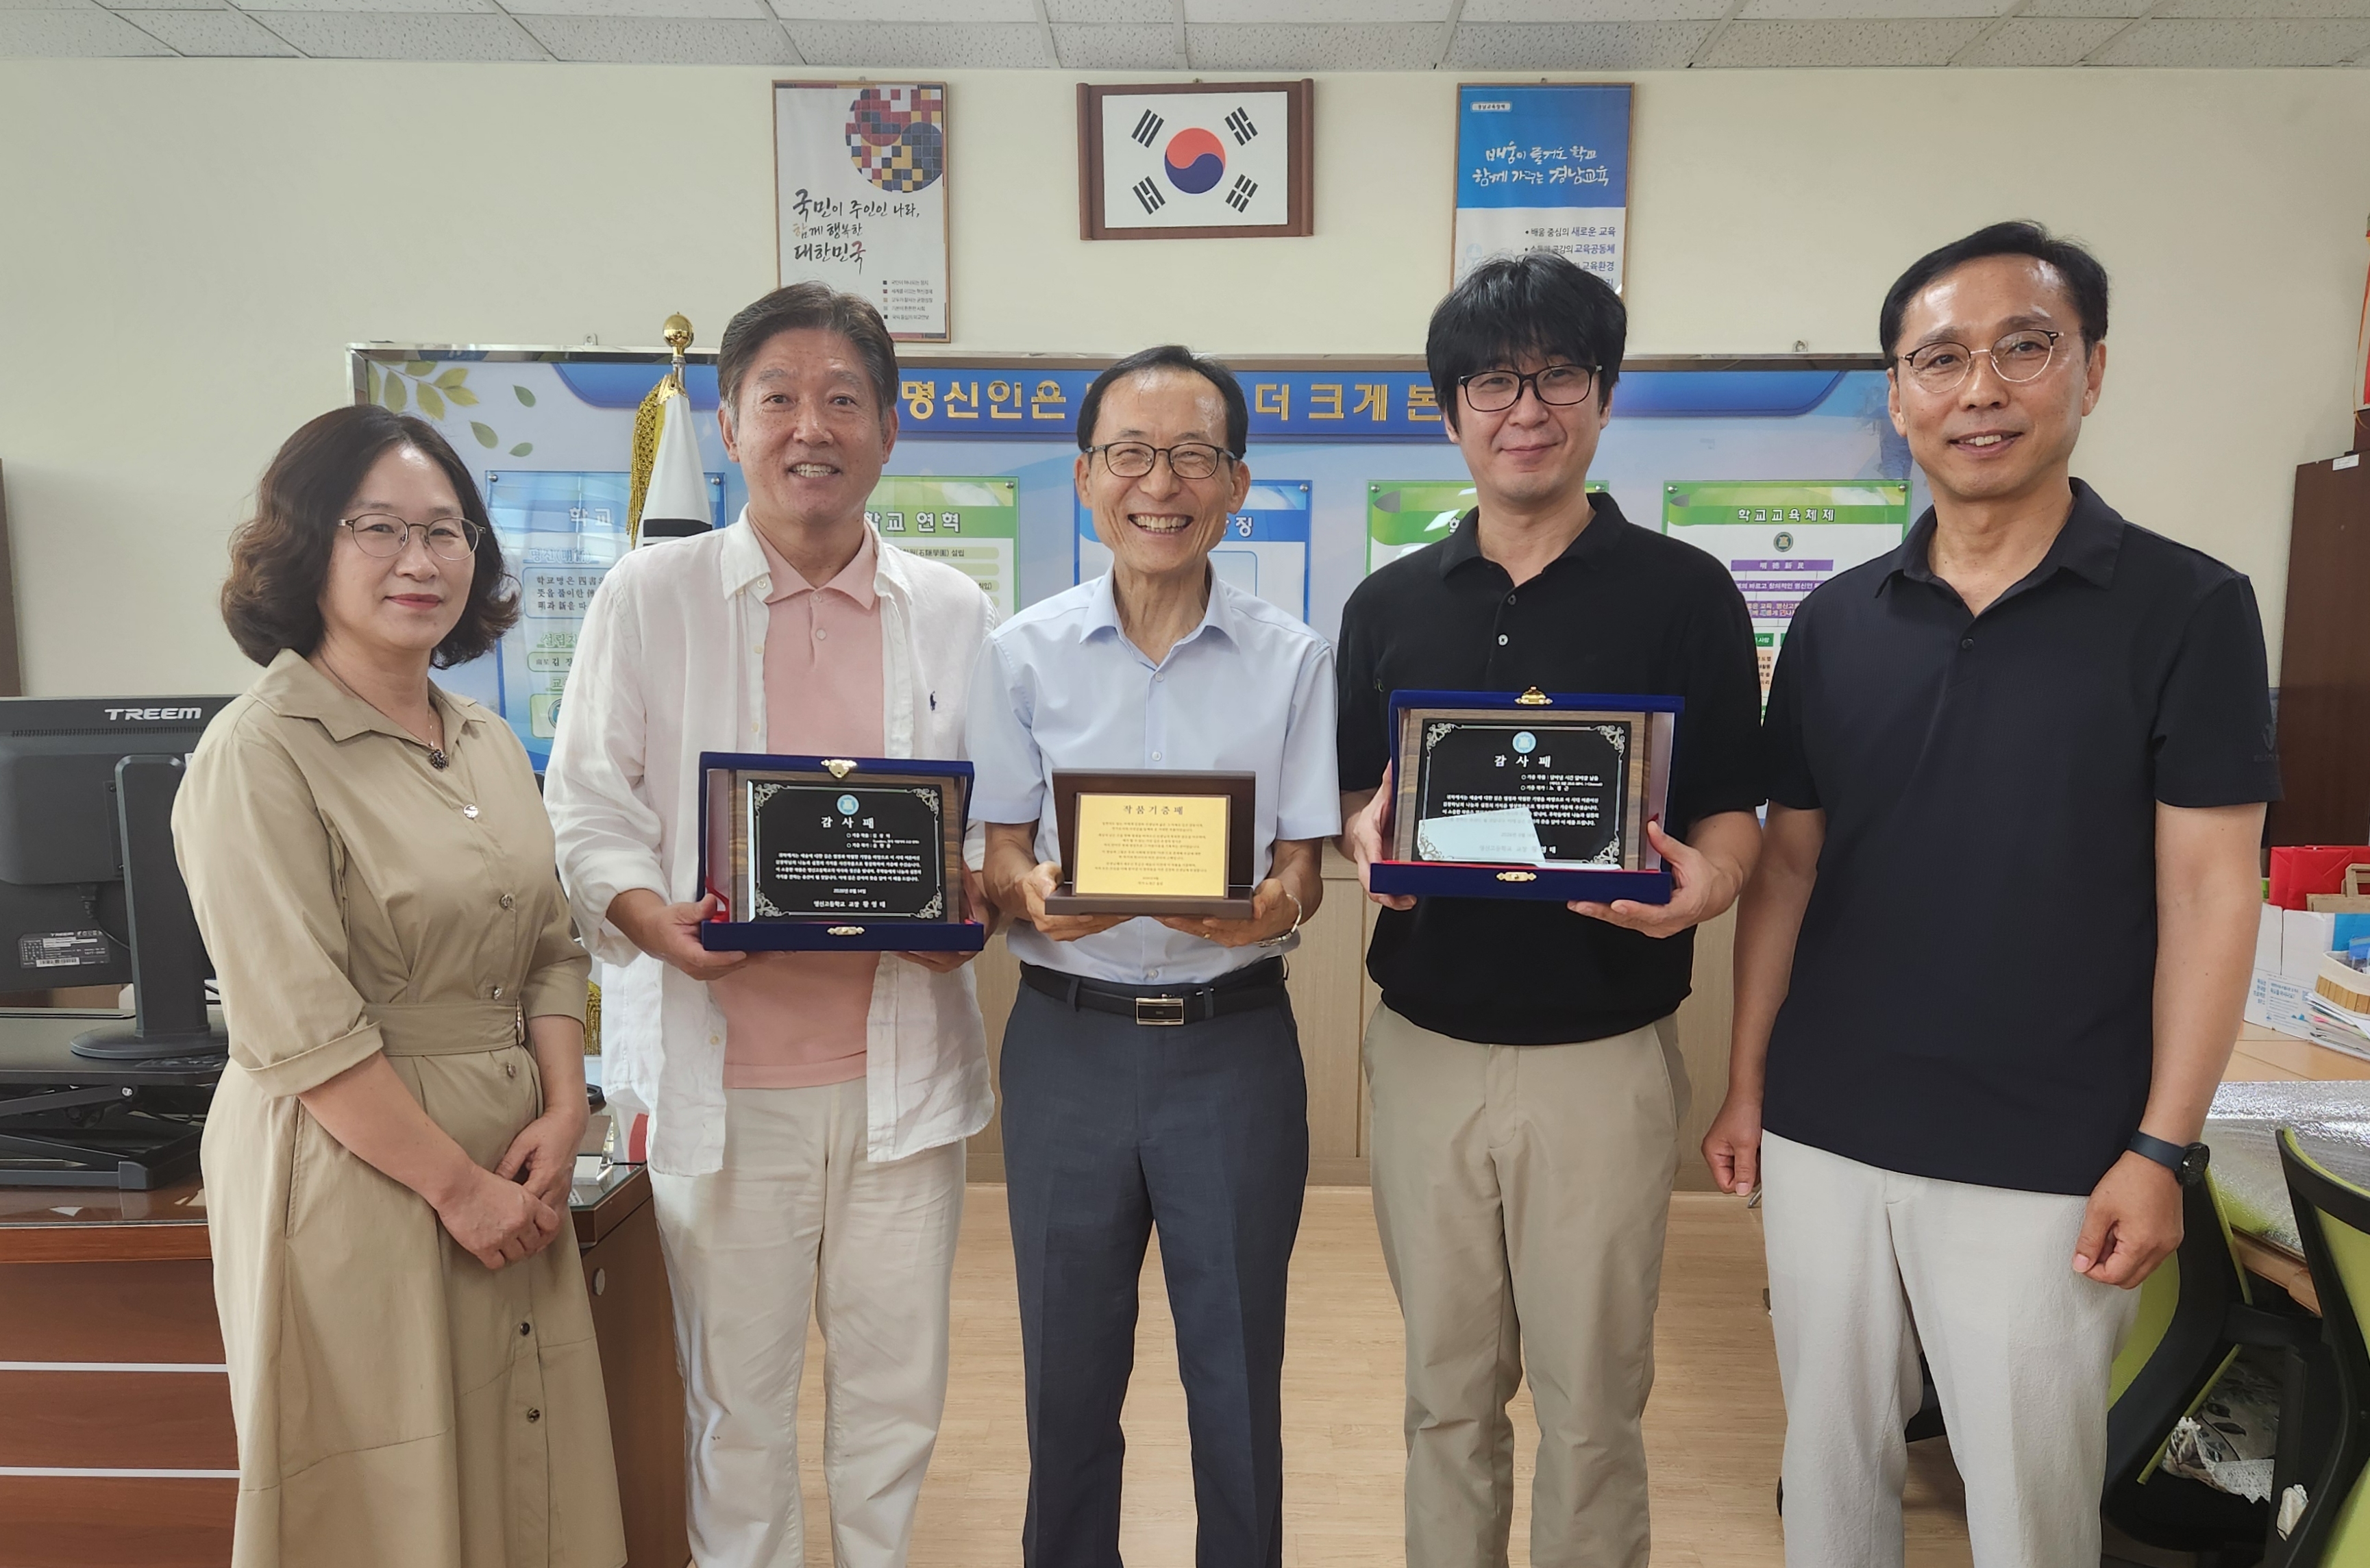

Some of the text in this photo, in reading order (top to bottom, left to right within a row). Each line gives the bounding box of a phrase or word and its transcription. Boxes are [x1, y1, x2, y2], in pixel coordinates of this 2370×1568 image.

[1530, 147, 1568, 165] 즐거운
[1569, 145, 1598, 162] 학교
[1472, 165, 1609, 187] 함께 가꾸는 경남교육
[793, 188, 920, 223] 국민이 주인인 나라,
[793, 222, 863, 238] 함께 행복한
[1548, 227, 1569, 237] 중심의
[1571, 227, 1596, 237] 새로운
[1598, 227, 1616, 237] 교육
[1574, 244, 1615, 254] 교육공동체
[793, 240, 866, 274] 대한민국
[1583, 261, 1614, 271] 교육환경
[901, 379, 1066, 420] 명신인은
[1255, 384, 1289, 421] 더
[1309, 384, 1387, 421] 크게
[569, 507, 613, 527] 학교
[916, 512, 959, 532] 연혁
[1738, 508, 1835, 522] 학교교육체제
[951, 549, 965, 557] 설립
[536, 575, 575, 585] 학교명은
[104, 707, 202, 721] TREEM
[1494, 755, 1552, 768] 감사패
[1123, 805, 1183, 815] 작품기증패
[821, 817, 875, 829] 감사패
